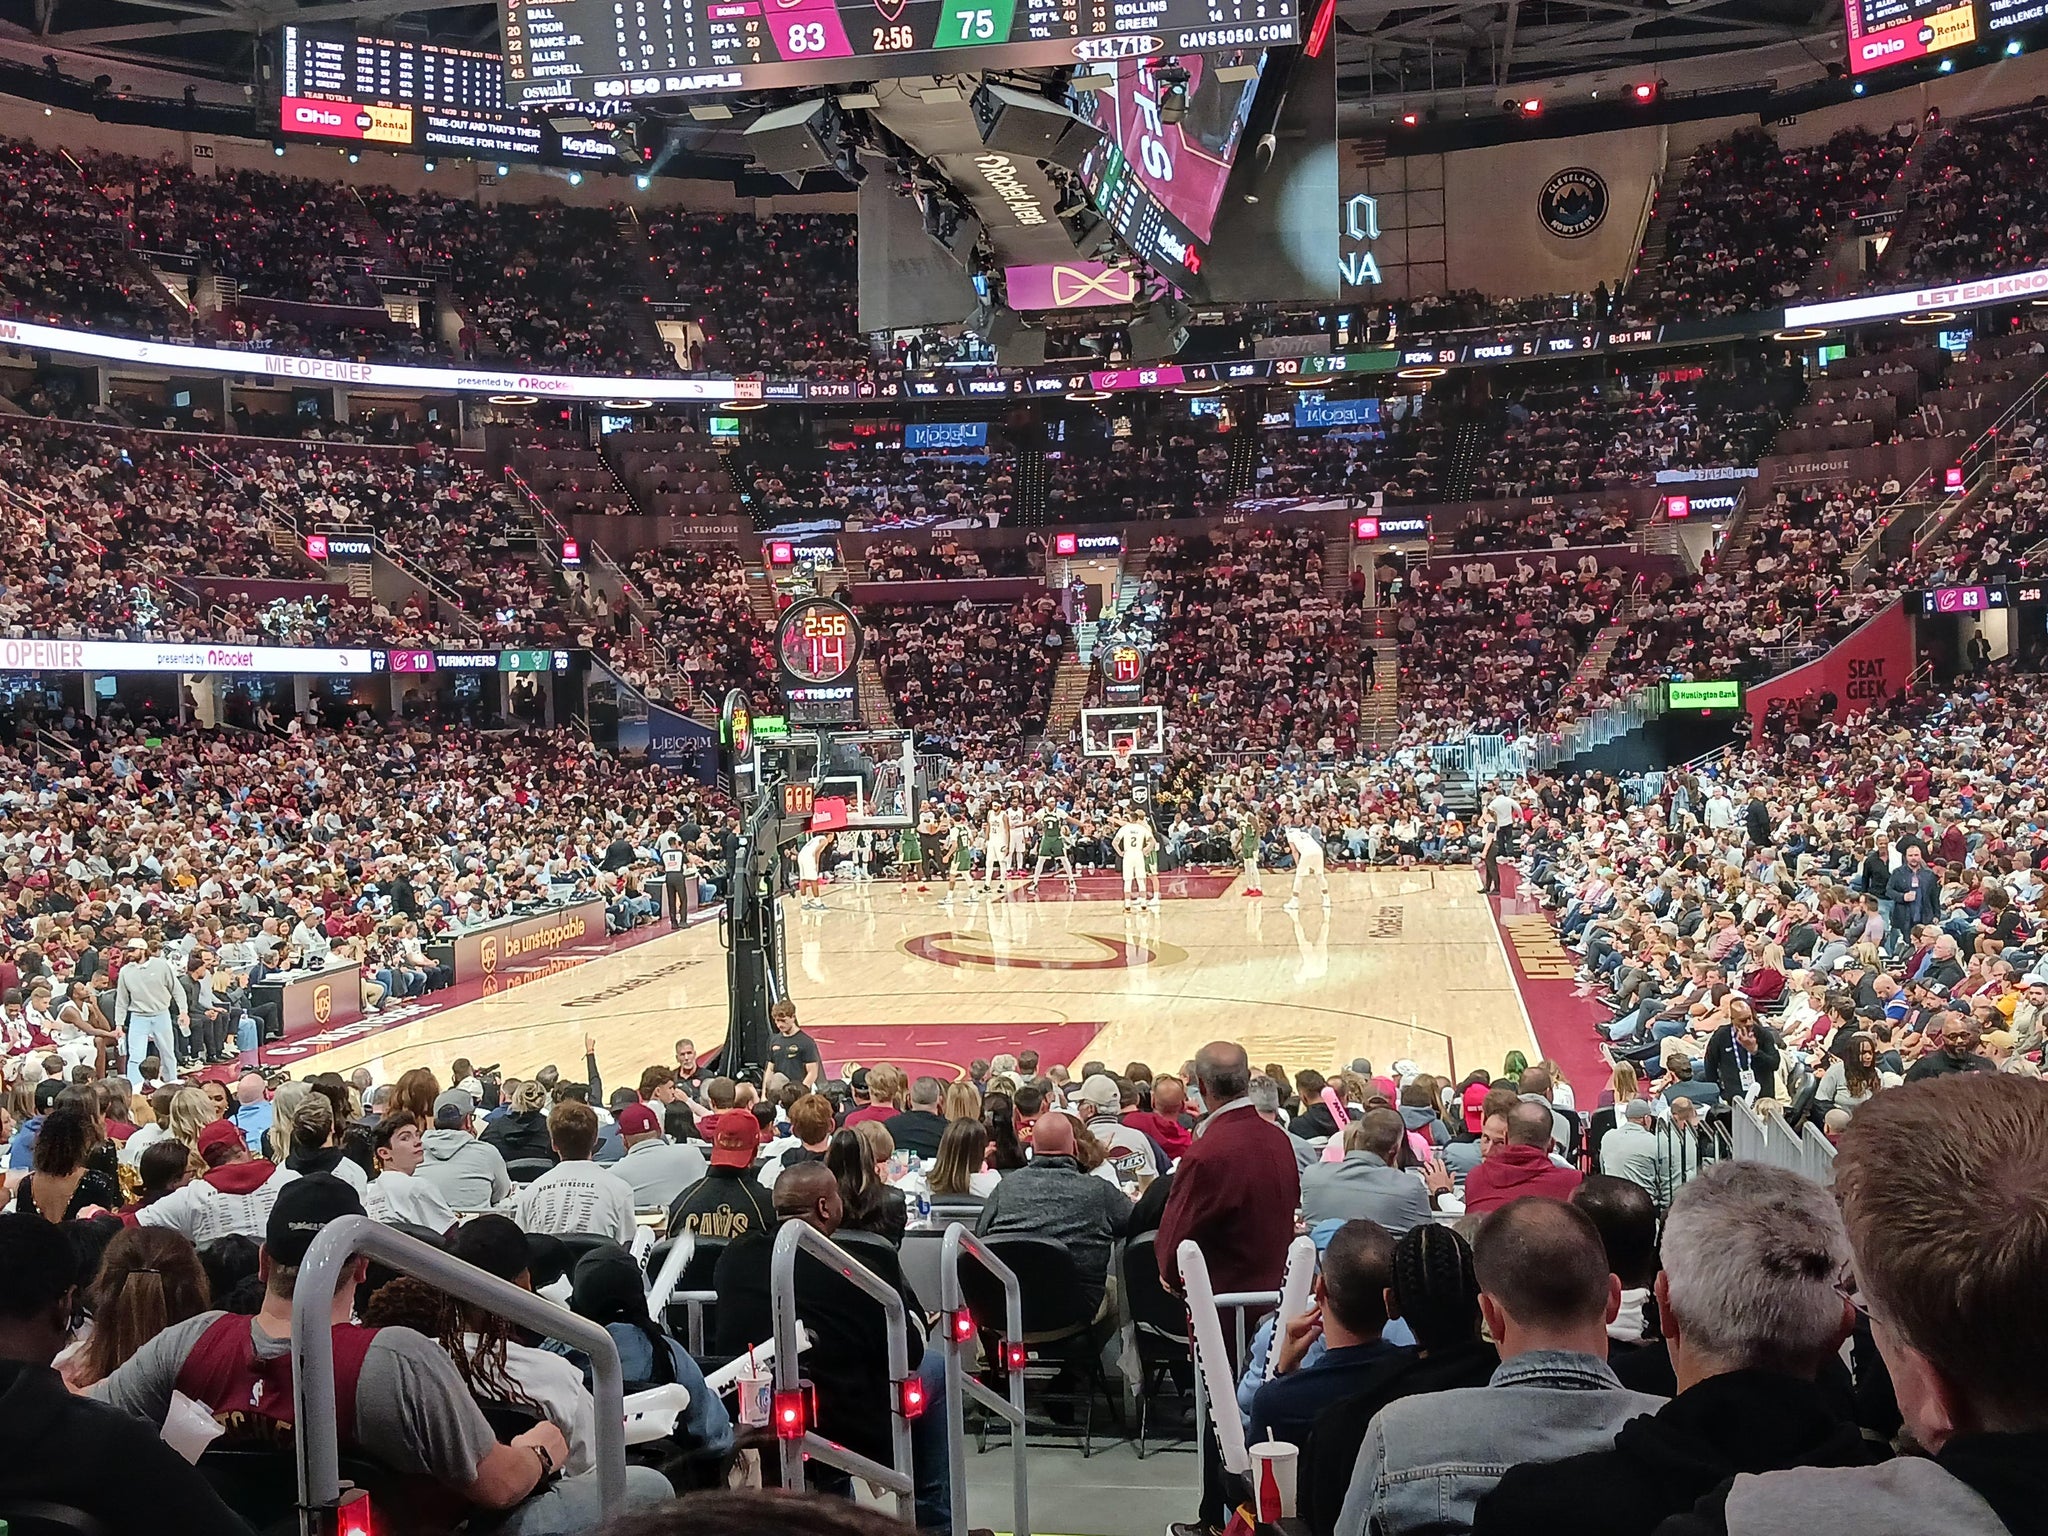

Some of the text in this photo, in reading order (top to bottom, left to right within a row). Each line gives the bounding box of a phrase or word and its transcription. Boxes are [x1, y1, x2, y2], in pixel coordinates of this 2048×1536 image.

[614, 2, 645, 14] 6 2
[1092, 7, 1106, 18] 13
[1114, 0, 1168, 16] ROLLINS
[1208, 3, 1289, 22] 14 2 3
[508, 8, 693, 27] 2 BALL 0 3
[956, 9, 995, 40] 75
[1029, 11, 1077, 24] 3PT 40
[1115, 16, 1158, 31] GREEN
[1989, 7, 2044, 30] CHALLENGE
[507, 22, 647, 43] 20 TYSON 5 4
[710, 22, 759, 34] FG 47
[1029, 24, 1078, 37] TOL 3
[1092, 22, 1106, 33] 20
[1867, 23, 1886, 33] TEAM
[1936, 19, 1970, 36] Rental
[711, 36, 761, 49] 3PT 29
[788, 22, 825, 53] 83
[873, 26, 913, 51] 2:56
[1179, 24, 1292, 49] CAVS5050.COM
[509, 35, 654, 55] 22 NANCE JR. 10
[1076, 36, 1153, 61] $13,718
[1862, 38, 1905, 60] Ohio
[509, 50, 696, 72] 31 ALLEN 13 3 3 0
[712, 52, 760, 65] TOL 4
[511, 63, 584, 79] 45 MITCHELL
[523, 80, 572, 98] oswald
[665, 73, 743, 92] RAFFLE
[304, 91, 324, 99] TEAM
[296, 108, 342, 125] Ohio
[375, 118, 408, 131] Rental
[428, 117, 541, 138] TIME-OUT AND THAT'S THEIR
[426, 133, 540, 154] CHALLENGE FOR THE NIGHT.
[194, 146, 213, 158] 214
[983, 155, 1047, 226] Rocket Arena
[1548, 174, 1597, 194] CLEVELAND
[1550, 214, 1596, 233] MONSTERS
[1916, 288, 1959, 307] LET
[1961, 283, 1995, 301] EM
[1549, 336, 1592, 351] TOL 3
[1609, 330, 1652, 344] 8:01 PM
[1404, 349, 1456, 364] FG% 50
[1475, 342, 1532, 358] FOULS 5
[265, 356, 373, 382] ME OPENER
[1275, 361, 1298, 375] 3Q
[1326, 356, 1346, 370] 75
[1139, 370, 1158, 384] 83
[1193, 368, 1206, 379] 14
[1229, 364, 1254, 378] 2:56
[457, 376, 514, 389] presented by
[766, 383, 799, 395] oswald
[881, 383, 898, 396] +8
[914, 382, 955, 394] TOL 4
[969, 380, 1022, 393] FOULS 5
[1035, 376, 1085, 390] FG% 47
[810, 385, 850, 397] $13,718
[1788, 460, 1849, 474] LITEHOUSE
[1690, 496, 1735, 510] TOYOTA
[683, 524, 739, 534] LITEHOUSE
[1379, 519, 1425, 531] TOYOTA
[328, 542, 371, 554] TOYOTA
[1077, 536, 1119, 547] TOYOTA
[792, 547, 834, 557] TOYOTA
[1962, 591, 1978, 606] 83
[2019, 589, 2041, 600] 2:56
[805, 615, 847, 637] 2:56
[6, 642, 83, 668] OPENER
[157, 650, 254, 667] presented by Rocket
[413, 655, 428, 669] 10
[437, 655, 497, 668] TURNOVERS
[510, 654, 520, 668] 9
[813, 637, 845, 674] 14
[374, 658, 385, 671] 47
[555, 658, 568, 669] 50
[1117, 661, 1135, 679] 14
[1847, 658, 1886, 679] SEAT
[806, 687, 854, 700] TISSOT
[1681, 690, 1737, 701] Huntington Bank
[1846, 678, 1888, 700] GEEK
[1130, 837, 1137, 848] 2
[504, 915, 586, 957] be unstoppable
[481, 947, 497, 968] ups
[776, 923, 786, 996] Cleveland
[315, 996, 331, 1020] ups
[686, 1212, 748, 1238] CAVS
